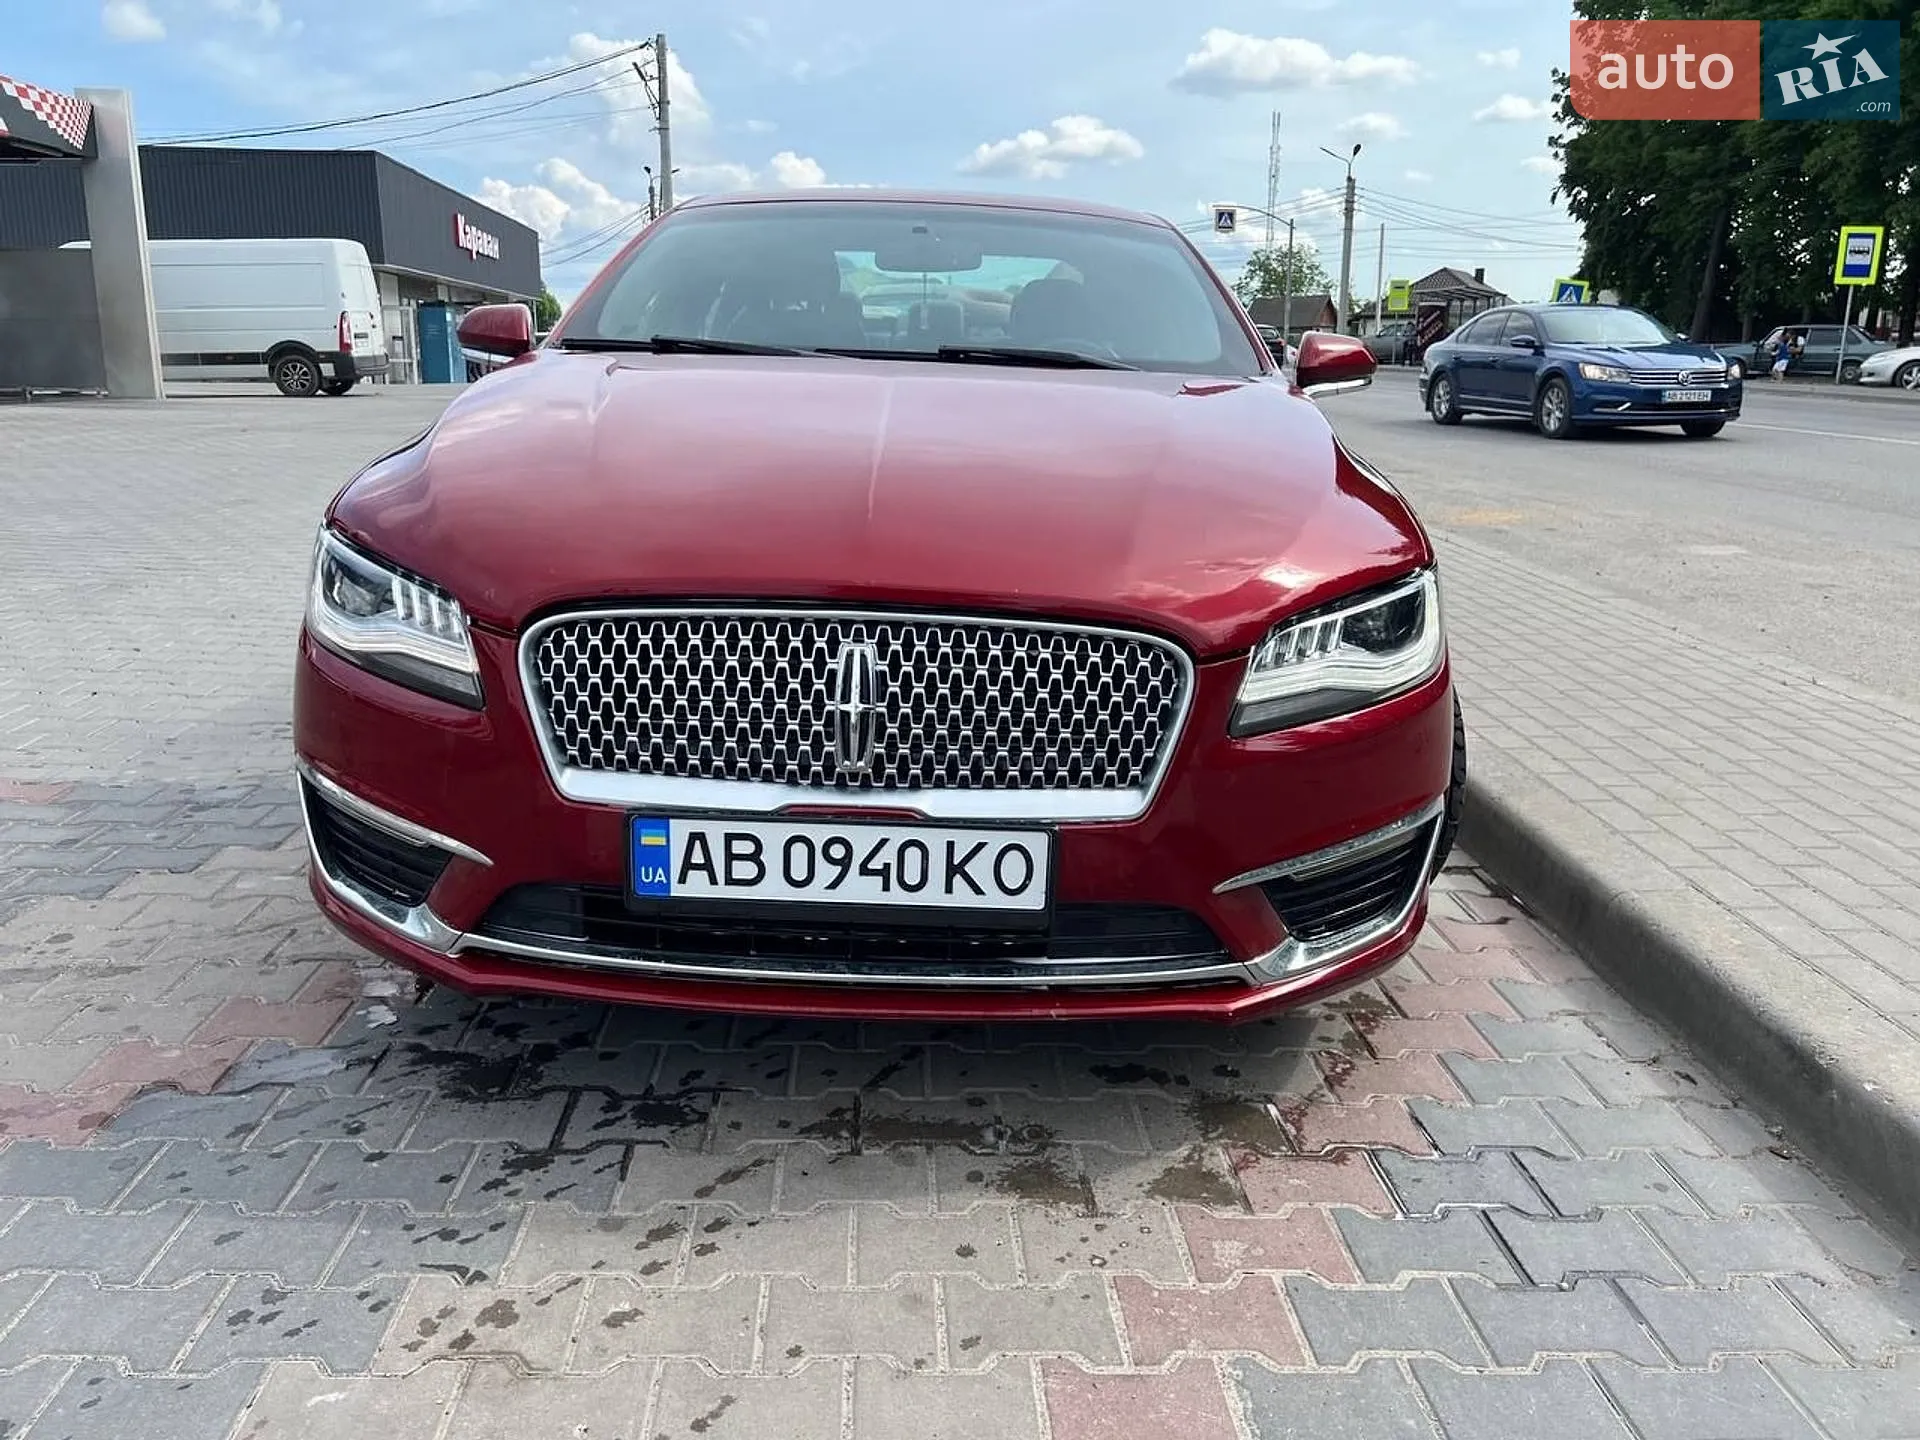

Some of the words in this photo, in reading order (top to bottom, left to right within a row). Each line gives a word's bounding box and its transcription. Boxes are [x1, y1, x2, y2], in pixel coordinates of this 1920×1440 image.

[457, 213, 500, 260] Караван
[641, 866, 667, 884] UA
[677, 831, 766, 887] AB
[782, 834, 929, 893] 0940
[944, 840, 1034, 897] KO
